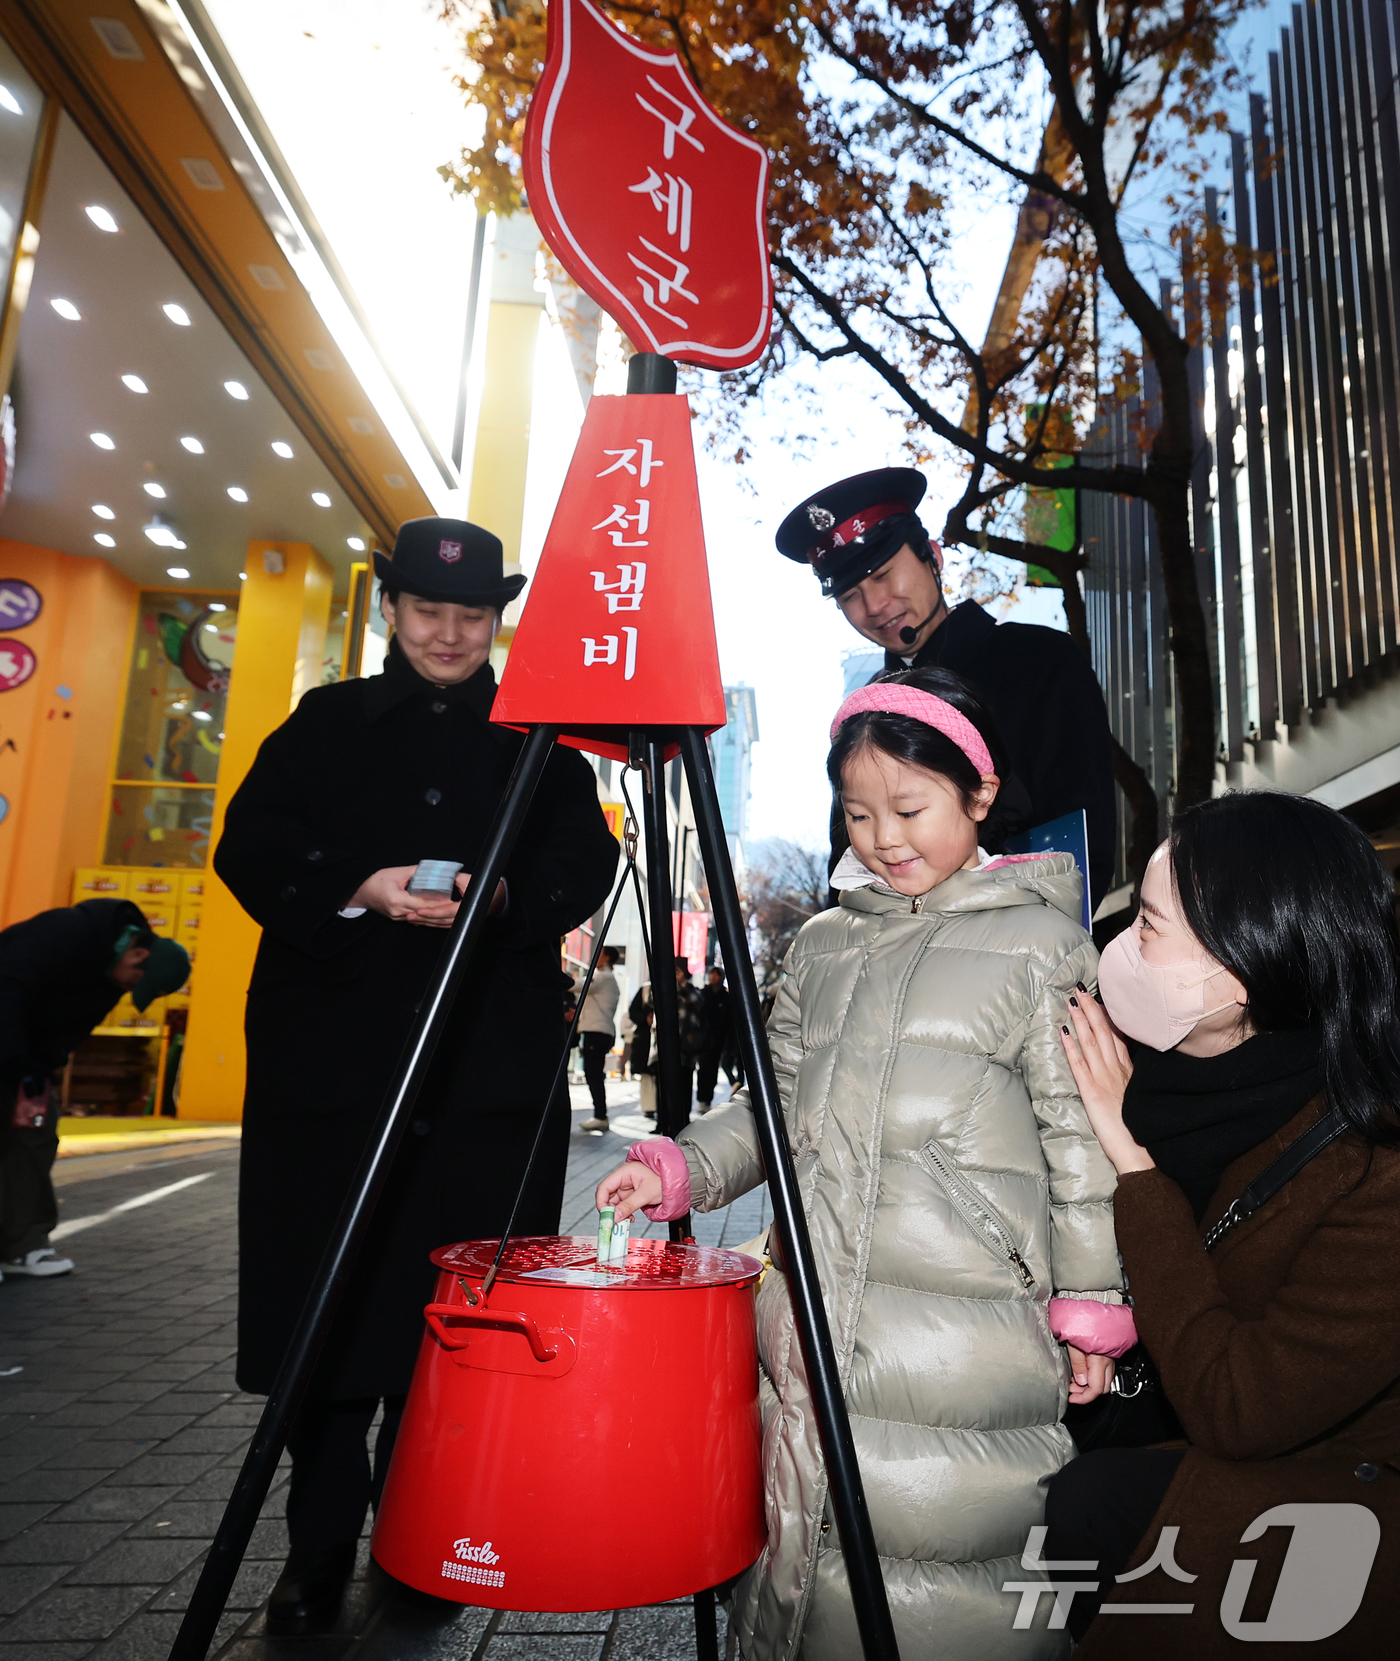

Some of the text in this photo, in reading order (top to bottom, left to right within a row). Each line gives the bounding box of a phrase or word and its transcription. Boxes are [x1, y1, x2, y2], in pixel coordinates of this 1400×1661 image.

[627, 74, 705, 330] 구세군
[581, 438, 664, 681] 자선냄비
[453, 1537, 500, 1566] Fissler
